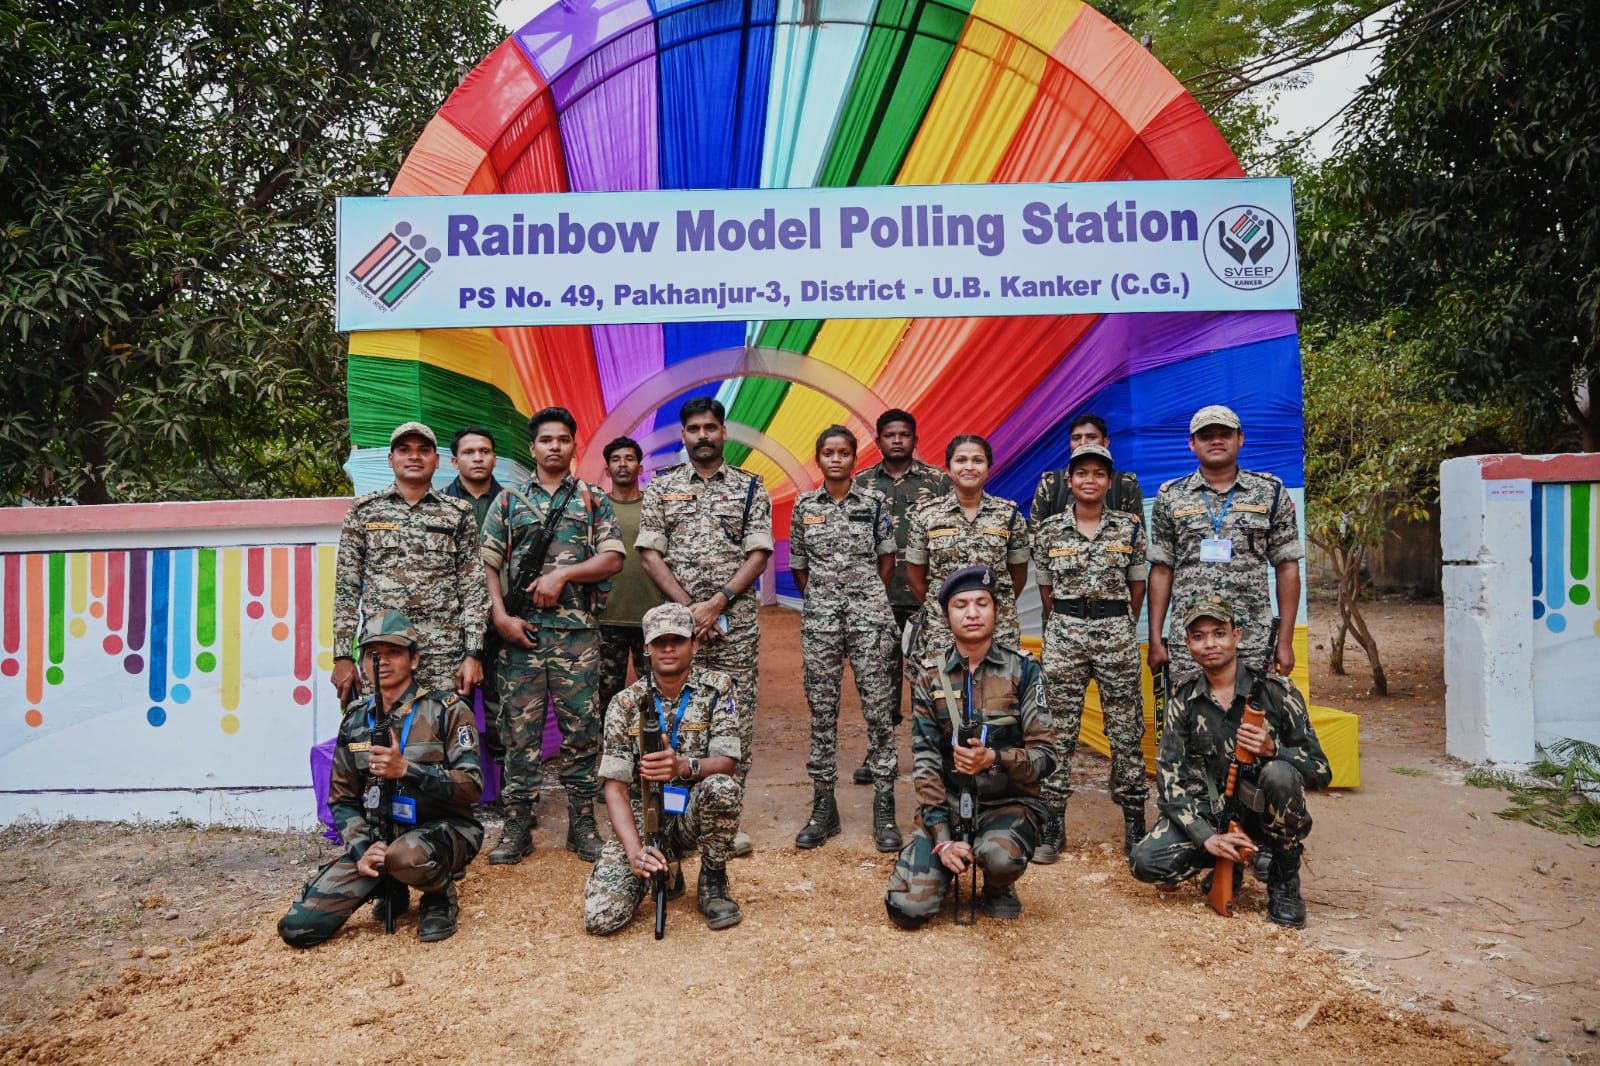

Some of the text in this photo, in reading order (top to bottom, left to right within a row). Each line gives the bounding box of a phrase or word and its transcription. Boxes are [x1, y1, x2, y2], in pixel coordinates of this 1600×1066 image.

[447, 200, 1199, 257] Rainbow Model Polling Station
[1224, 267, 1273, 276] SVEEP
[459, 286, 496, 309] PS
[505, 286, 551, 307] No.
[560, 284, 604, 311] 49,
[613, 280, 791, 309] Pakhanjur-3,
[800, 278, 906, 303] District
[932, 277, 991, 299] U.B.
[1000, 275, 1102, 298] Kanker
[1111, 272, 1190, 301] (C.G.)
